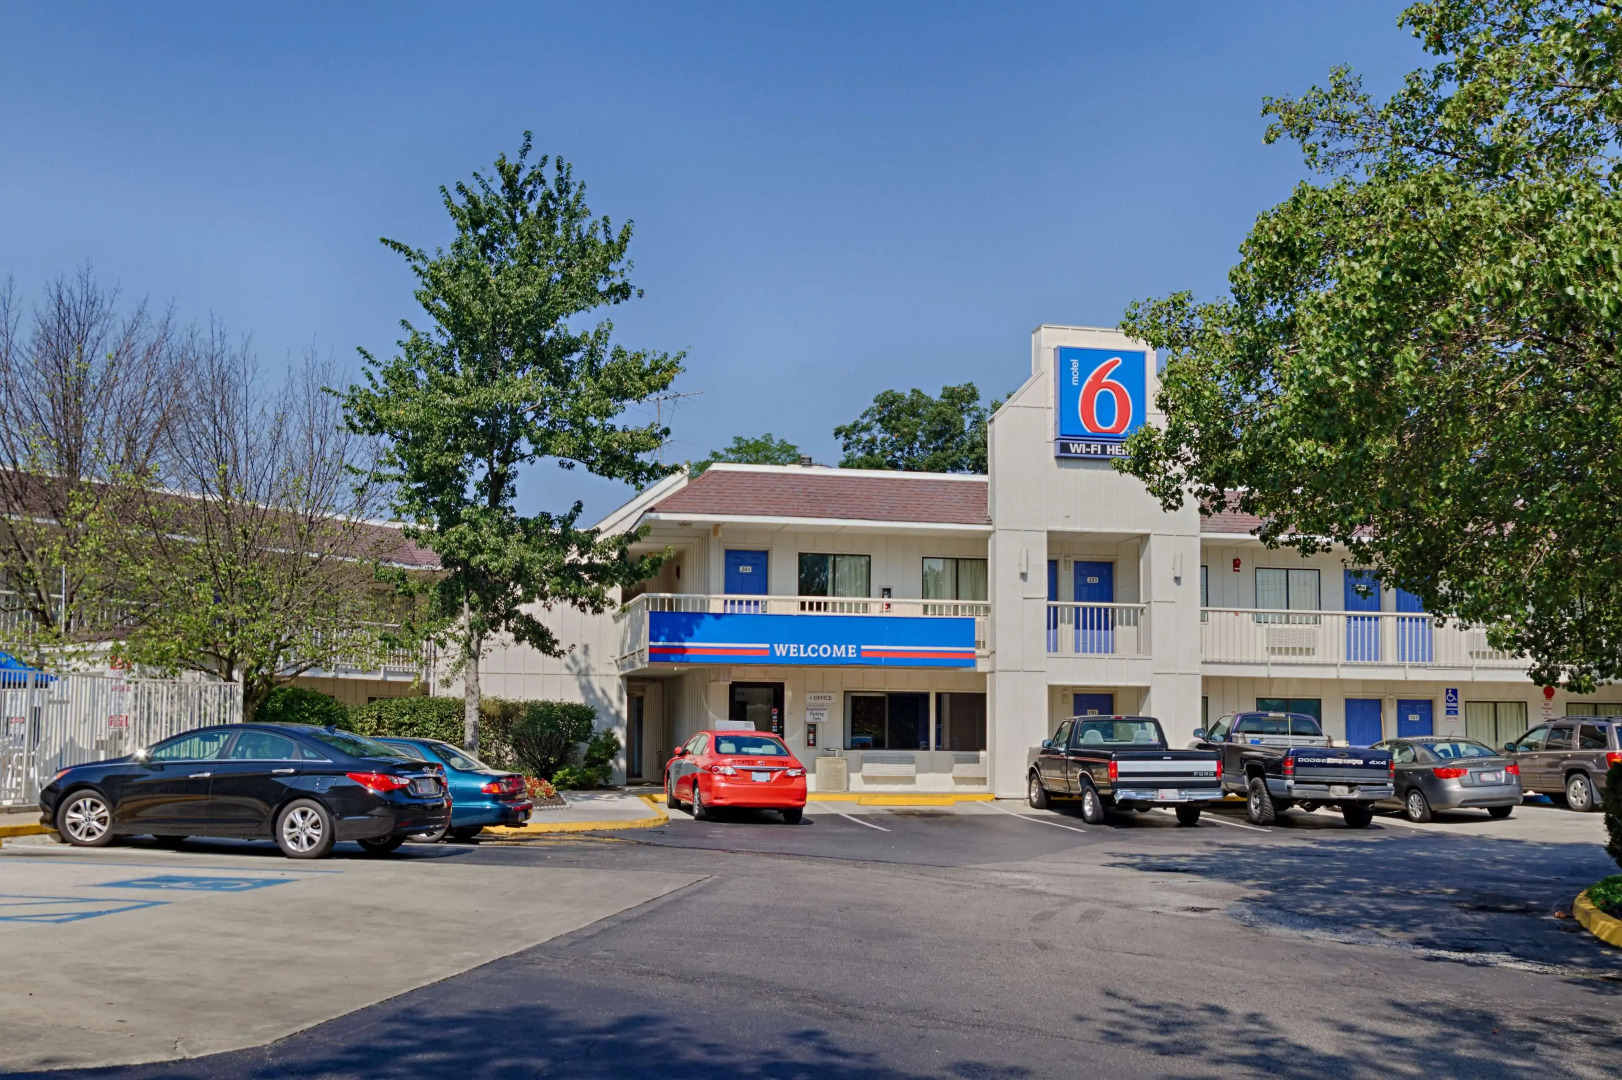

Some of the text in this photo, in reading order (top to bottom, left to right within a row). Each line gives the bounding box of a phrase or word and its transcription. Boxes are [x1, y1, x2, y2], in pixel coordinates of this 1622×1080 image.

[1070, 359, 1079, 386] motel
[1078, 357, 1133, 434] 6
[1069, 443, 1101, 455] WI-FI
[773, 643, 857, 658] WELCOME
